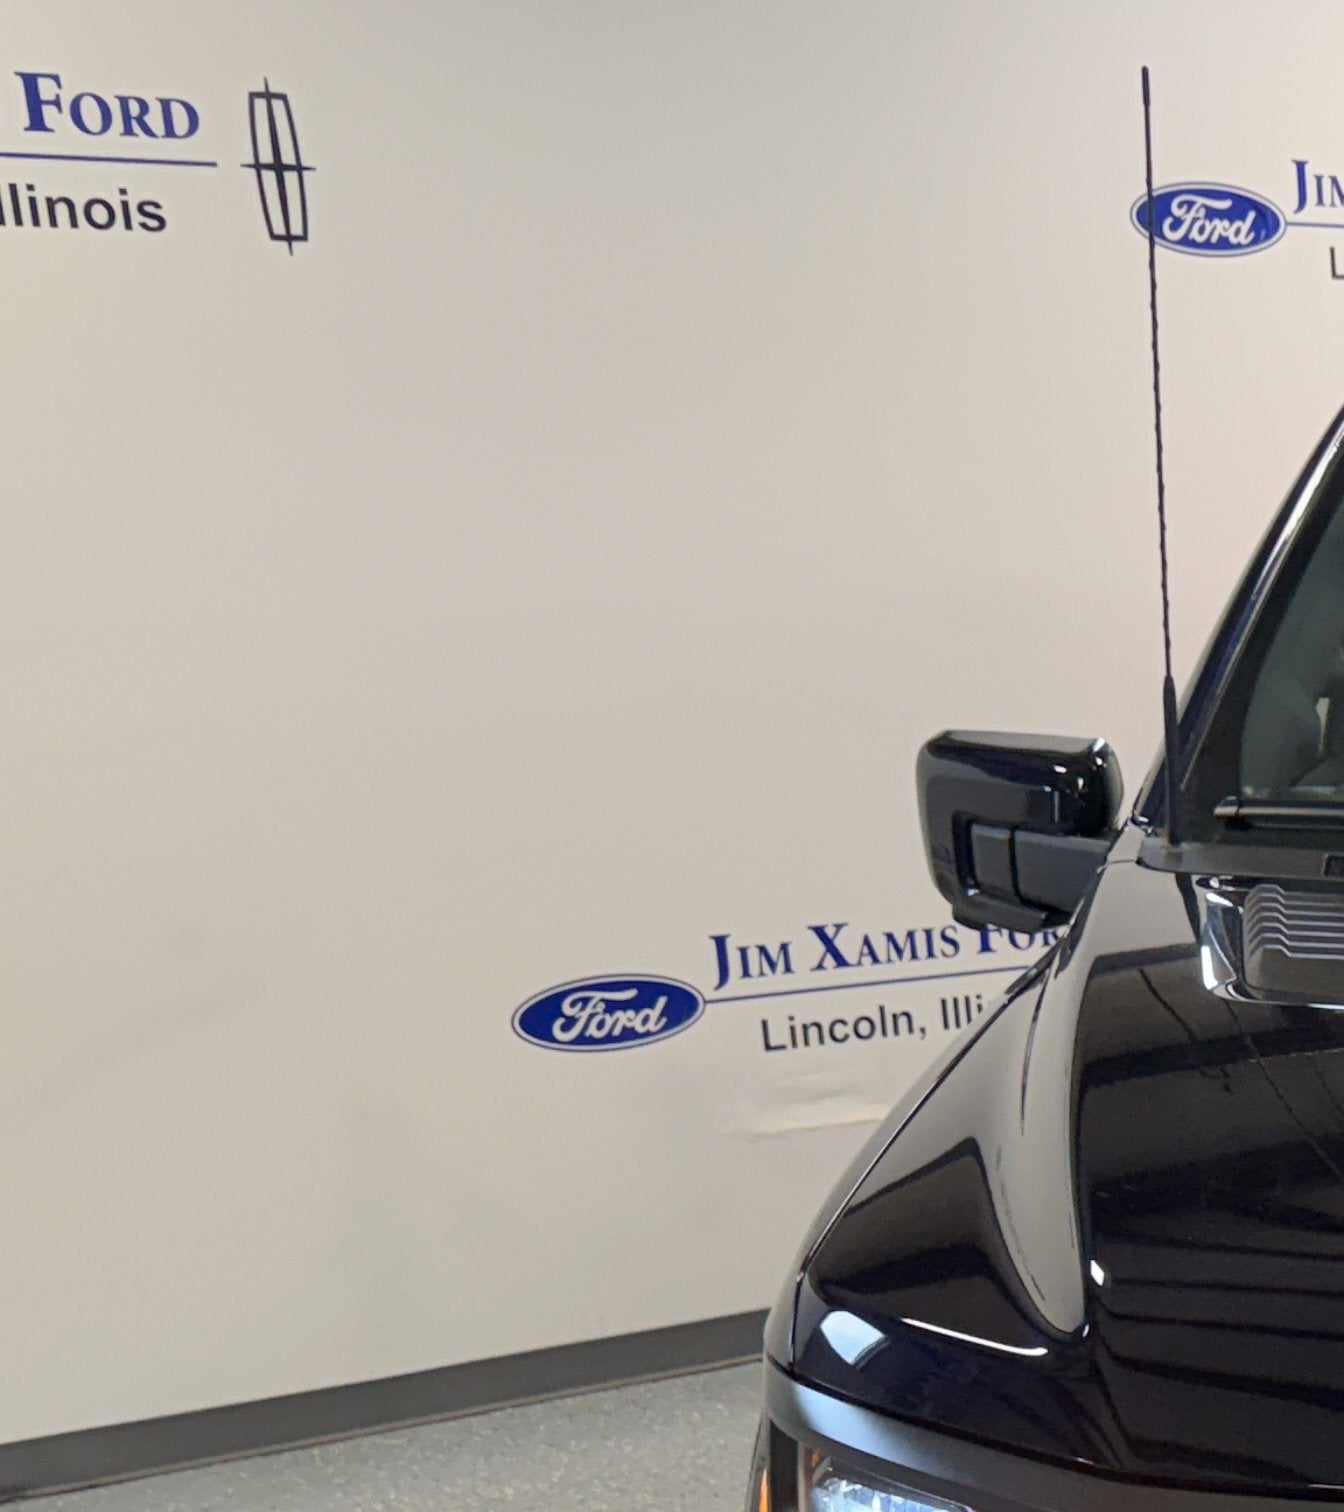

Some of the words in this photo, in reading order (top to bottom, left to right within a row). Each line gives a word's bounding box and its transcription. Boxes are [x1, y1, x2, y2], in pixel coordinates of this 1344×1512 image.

[0, 181, 167, 233] linois
[1162, 193, 1257, 246] Ford
[977, 923, 1061, 953] FOR
[552, 988, 668, 1043] Ford
[760, 1004, 928, 1053] Lincoln,
[940, 993, 984, 1031] Illi
